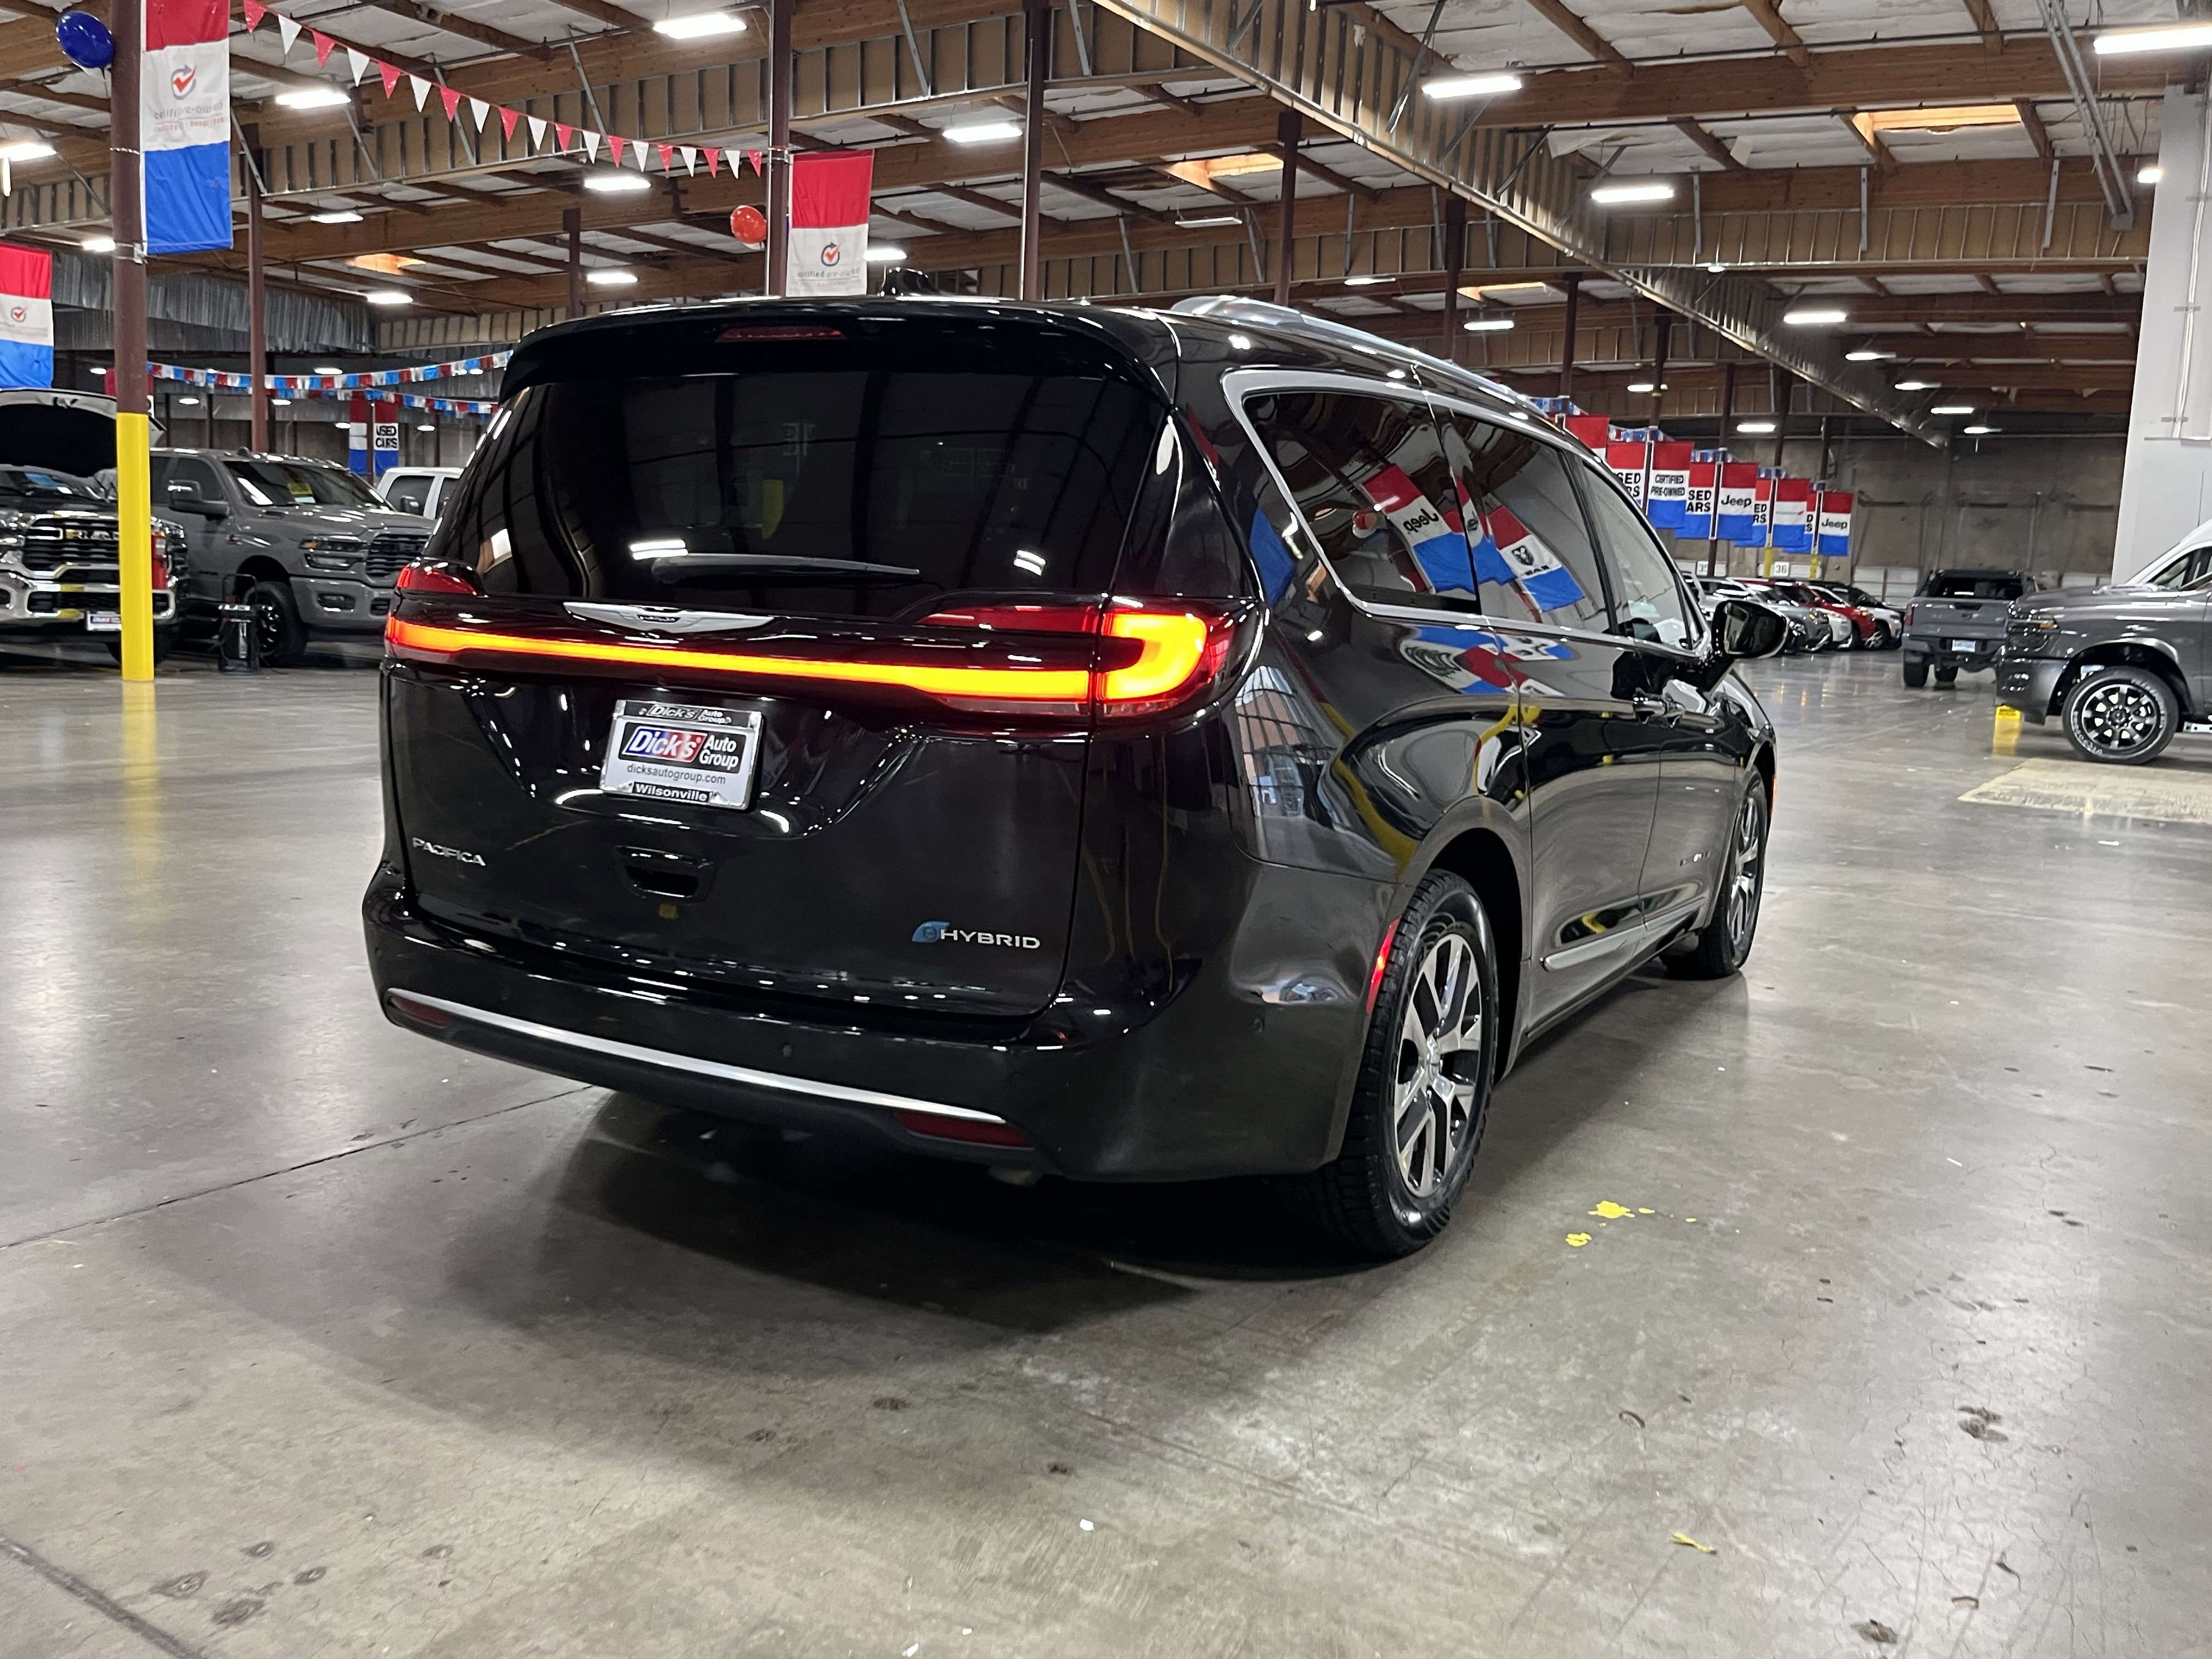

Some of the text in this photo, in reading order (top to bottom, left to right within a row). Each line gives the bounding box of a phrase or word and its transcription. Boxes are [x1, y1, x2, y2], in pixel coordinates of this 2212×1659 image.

[1688, 490, 1712, 500] SED
[1720, 495, 1752, 509] Jeep
[1686, 502, 1711, 512] ARS
[1821, 518, 1848, 529] Jeep
[1775, 565, 1787, 574] 36
[651, 706, 696, 718] Dick's
[702, 709, 723, 718] Auto
[698, 715, 725, 724] Group
[629, 727, 697, 759] Dick's
[704, 735, 737, 753] Auto
[699, 751, 739, 770] Group
[628, 763, 726, 785] dicksautogroup.com
[635, 783, 708, 802] Wilsonville
[413, 837, 486, 866] PACIFICA
[940, 929, 1041, 949] HYBRID
